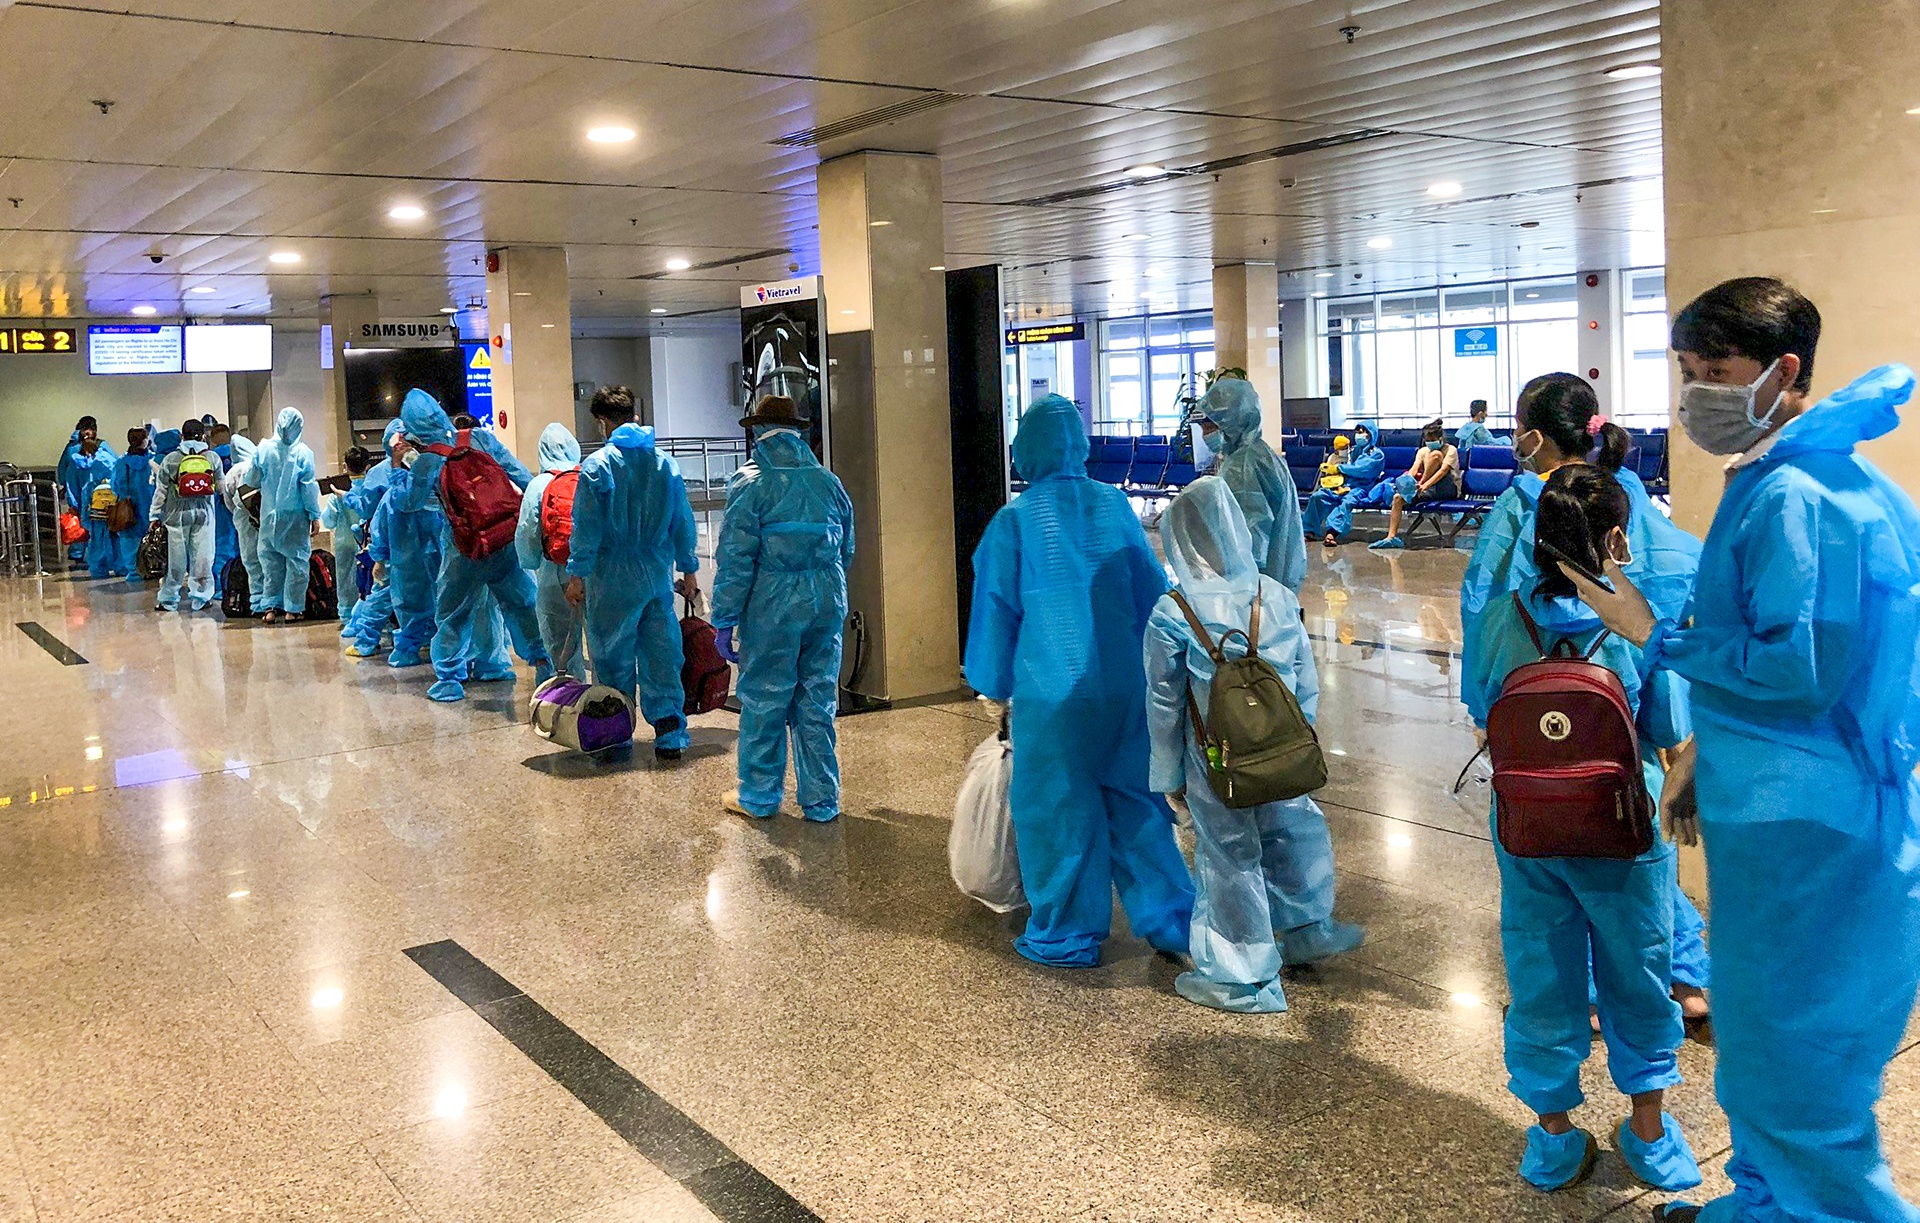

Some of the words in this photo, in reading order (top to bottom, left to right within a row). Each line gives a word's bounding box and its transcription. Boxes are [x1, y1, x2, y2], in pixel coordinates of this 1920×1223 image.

[766, 285, 801, 298] Vietravel
[362, 324, 439, 336] SAMSUNG
[0, 332, 8, 350] 1
[53, 331, 70, 350] 2
